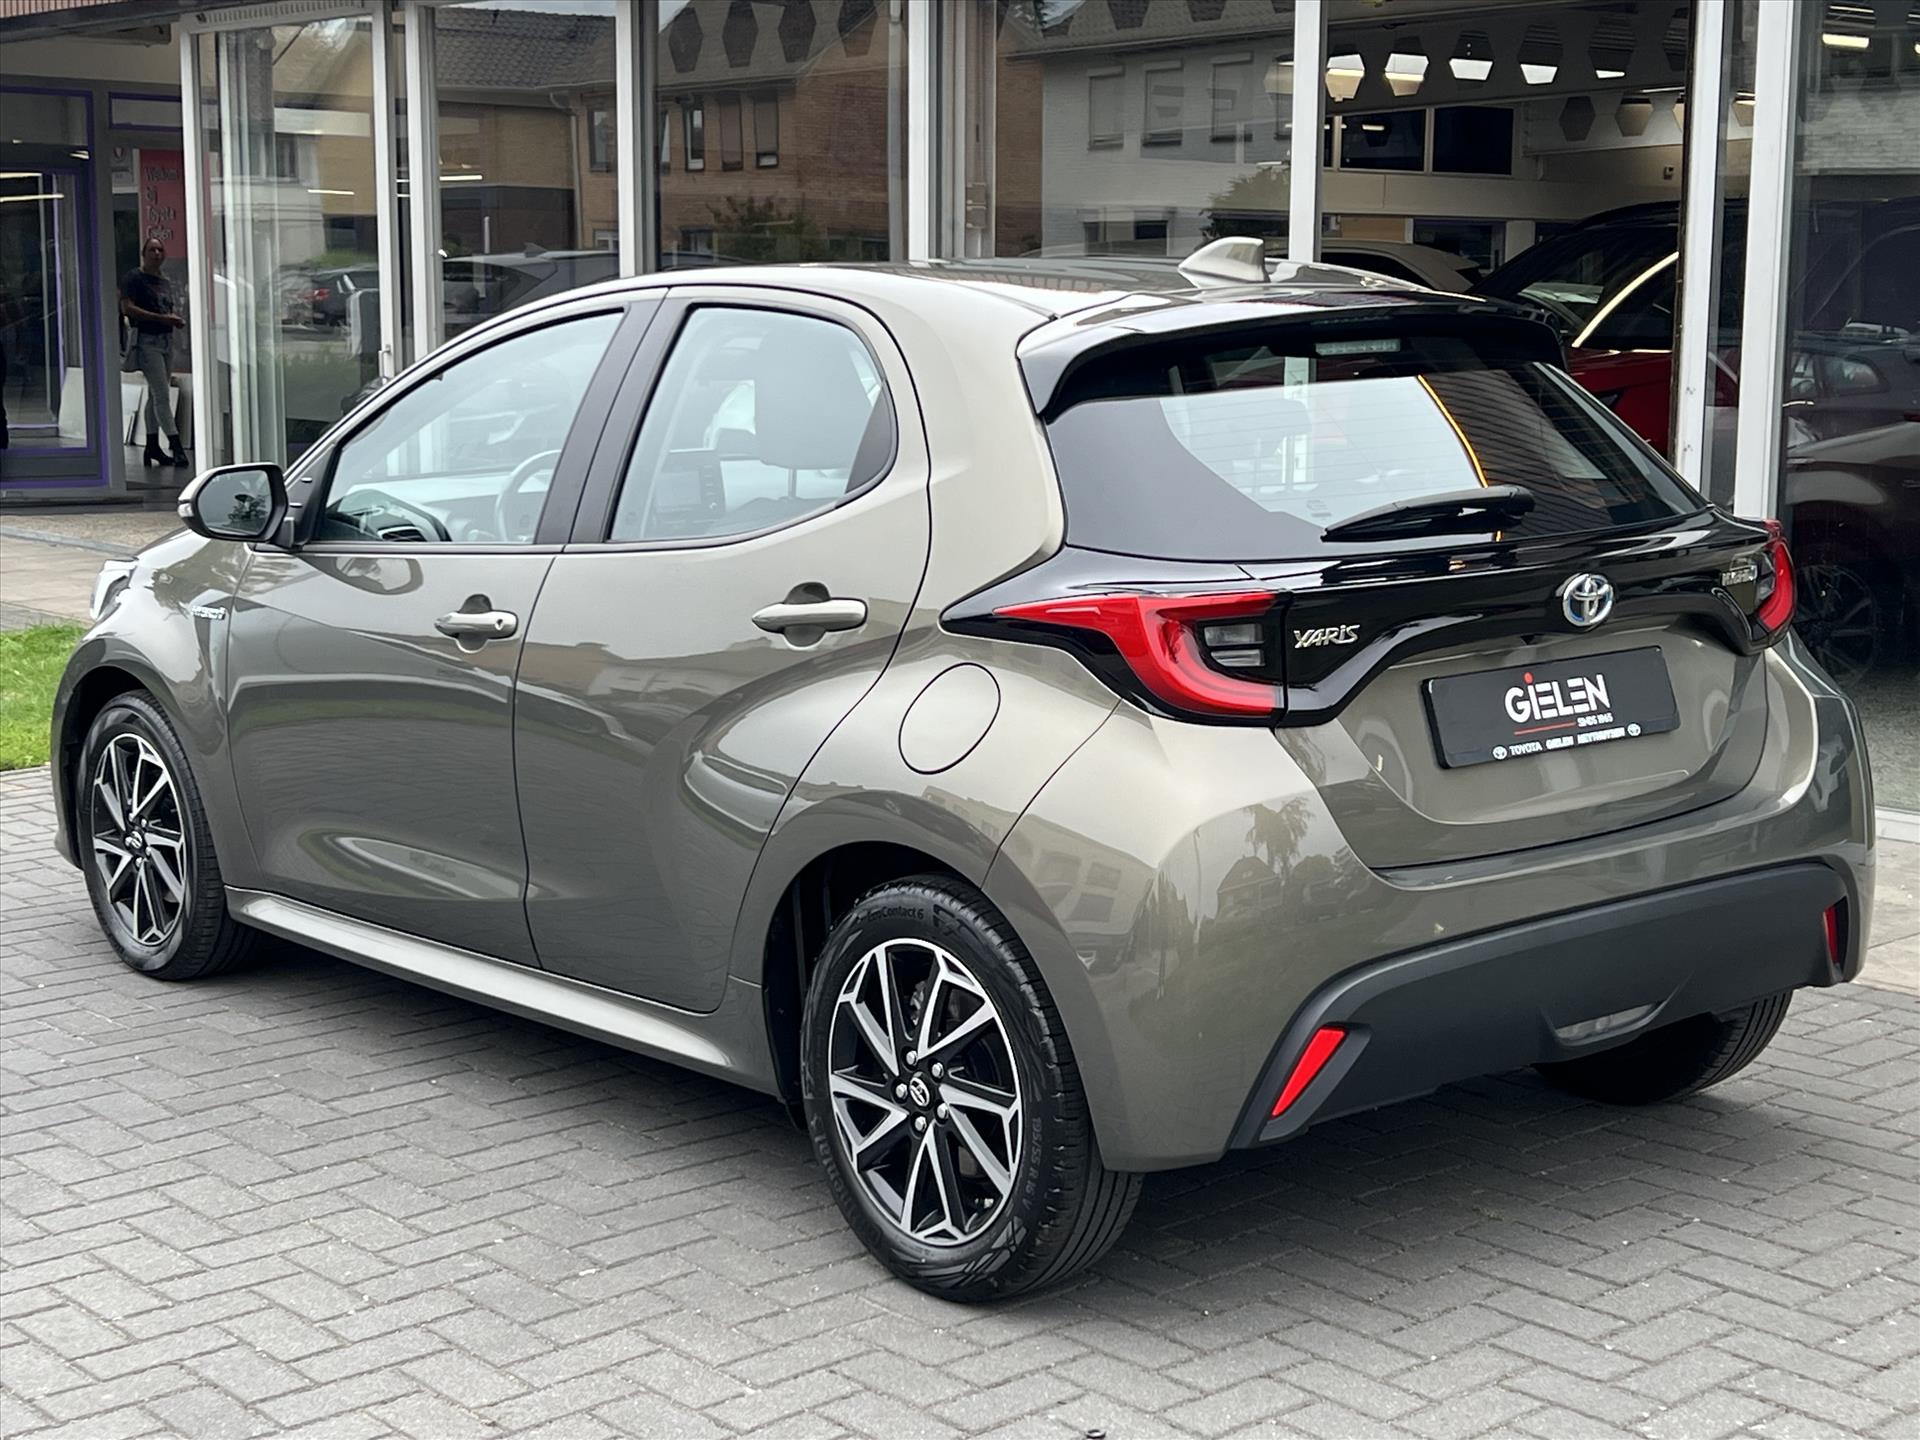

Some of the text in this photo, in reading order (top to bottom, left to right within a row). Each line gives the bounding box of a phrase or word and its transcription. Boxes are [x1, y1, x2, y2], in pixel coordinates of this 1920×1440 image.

[1293, 624, 1360, 649] YARIS
[1504, 671, 1611, 724] GIELEN
[1509, 741, 1543, 756] TOYOTA
